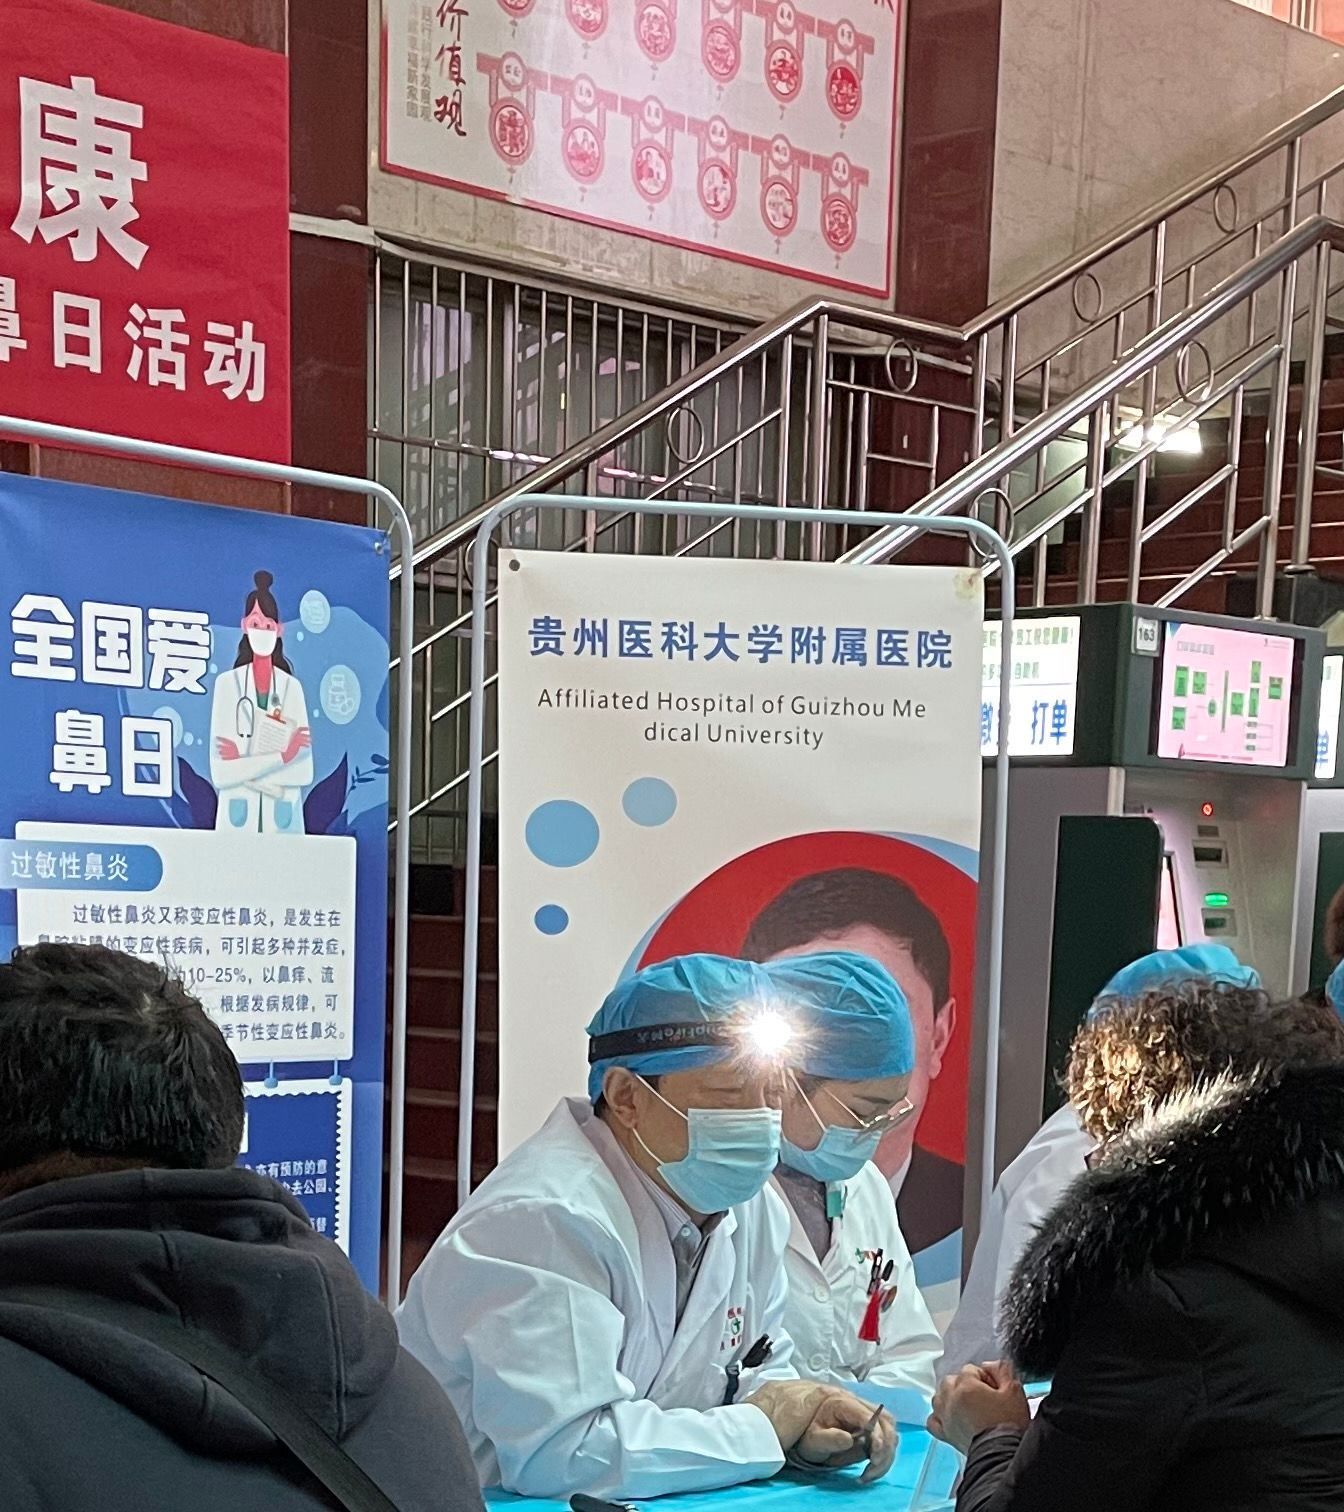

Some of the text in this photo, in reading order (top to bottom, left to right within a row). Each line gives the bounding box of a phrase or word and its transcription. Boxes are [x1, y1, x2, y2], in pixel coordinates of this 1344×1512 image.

[10, 594, 212, 695] 全国爱
[527, 615, 954, 670] 贵州医科大学附属医院
[1138, 627, 1155, 642] 163
[537, 687, 927, 719] Affiliated Hospital of Guizhou Me
[643, 721, 825, 751] dical University
[1030, 699, 1069, 746] 打单
[49, 708, 174, 798] 鼻日
[10, 850, 130, 882] 过敏性鼻炎
[72, 904, 343, 927] 过敏性鼻炎又称变应性鼻炎，是发生在
